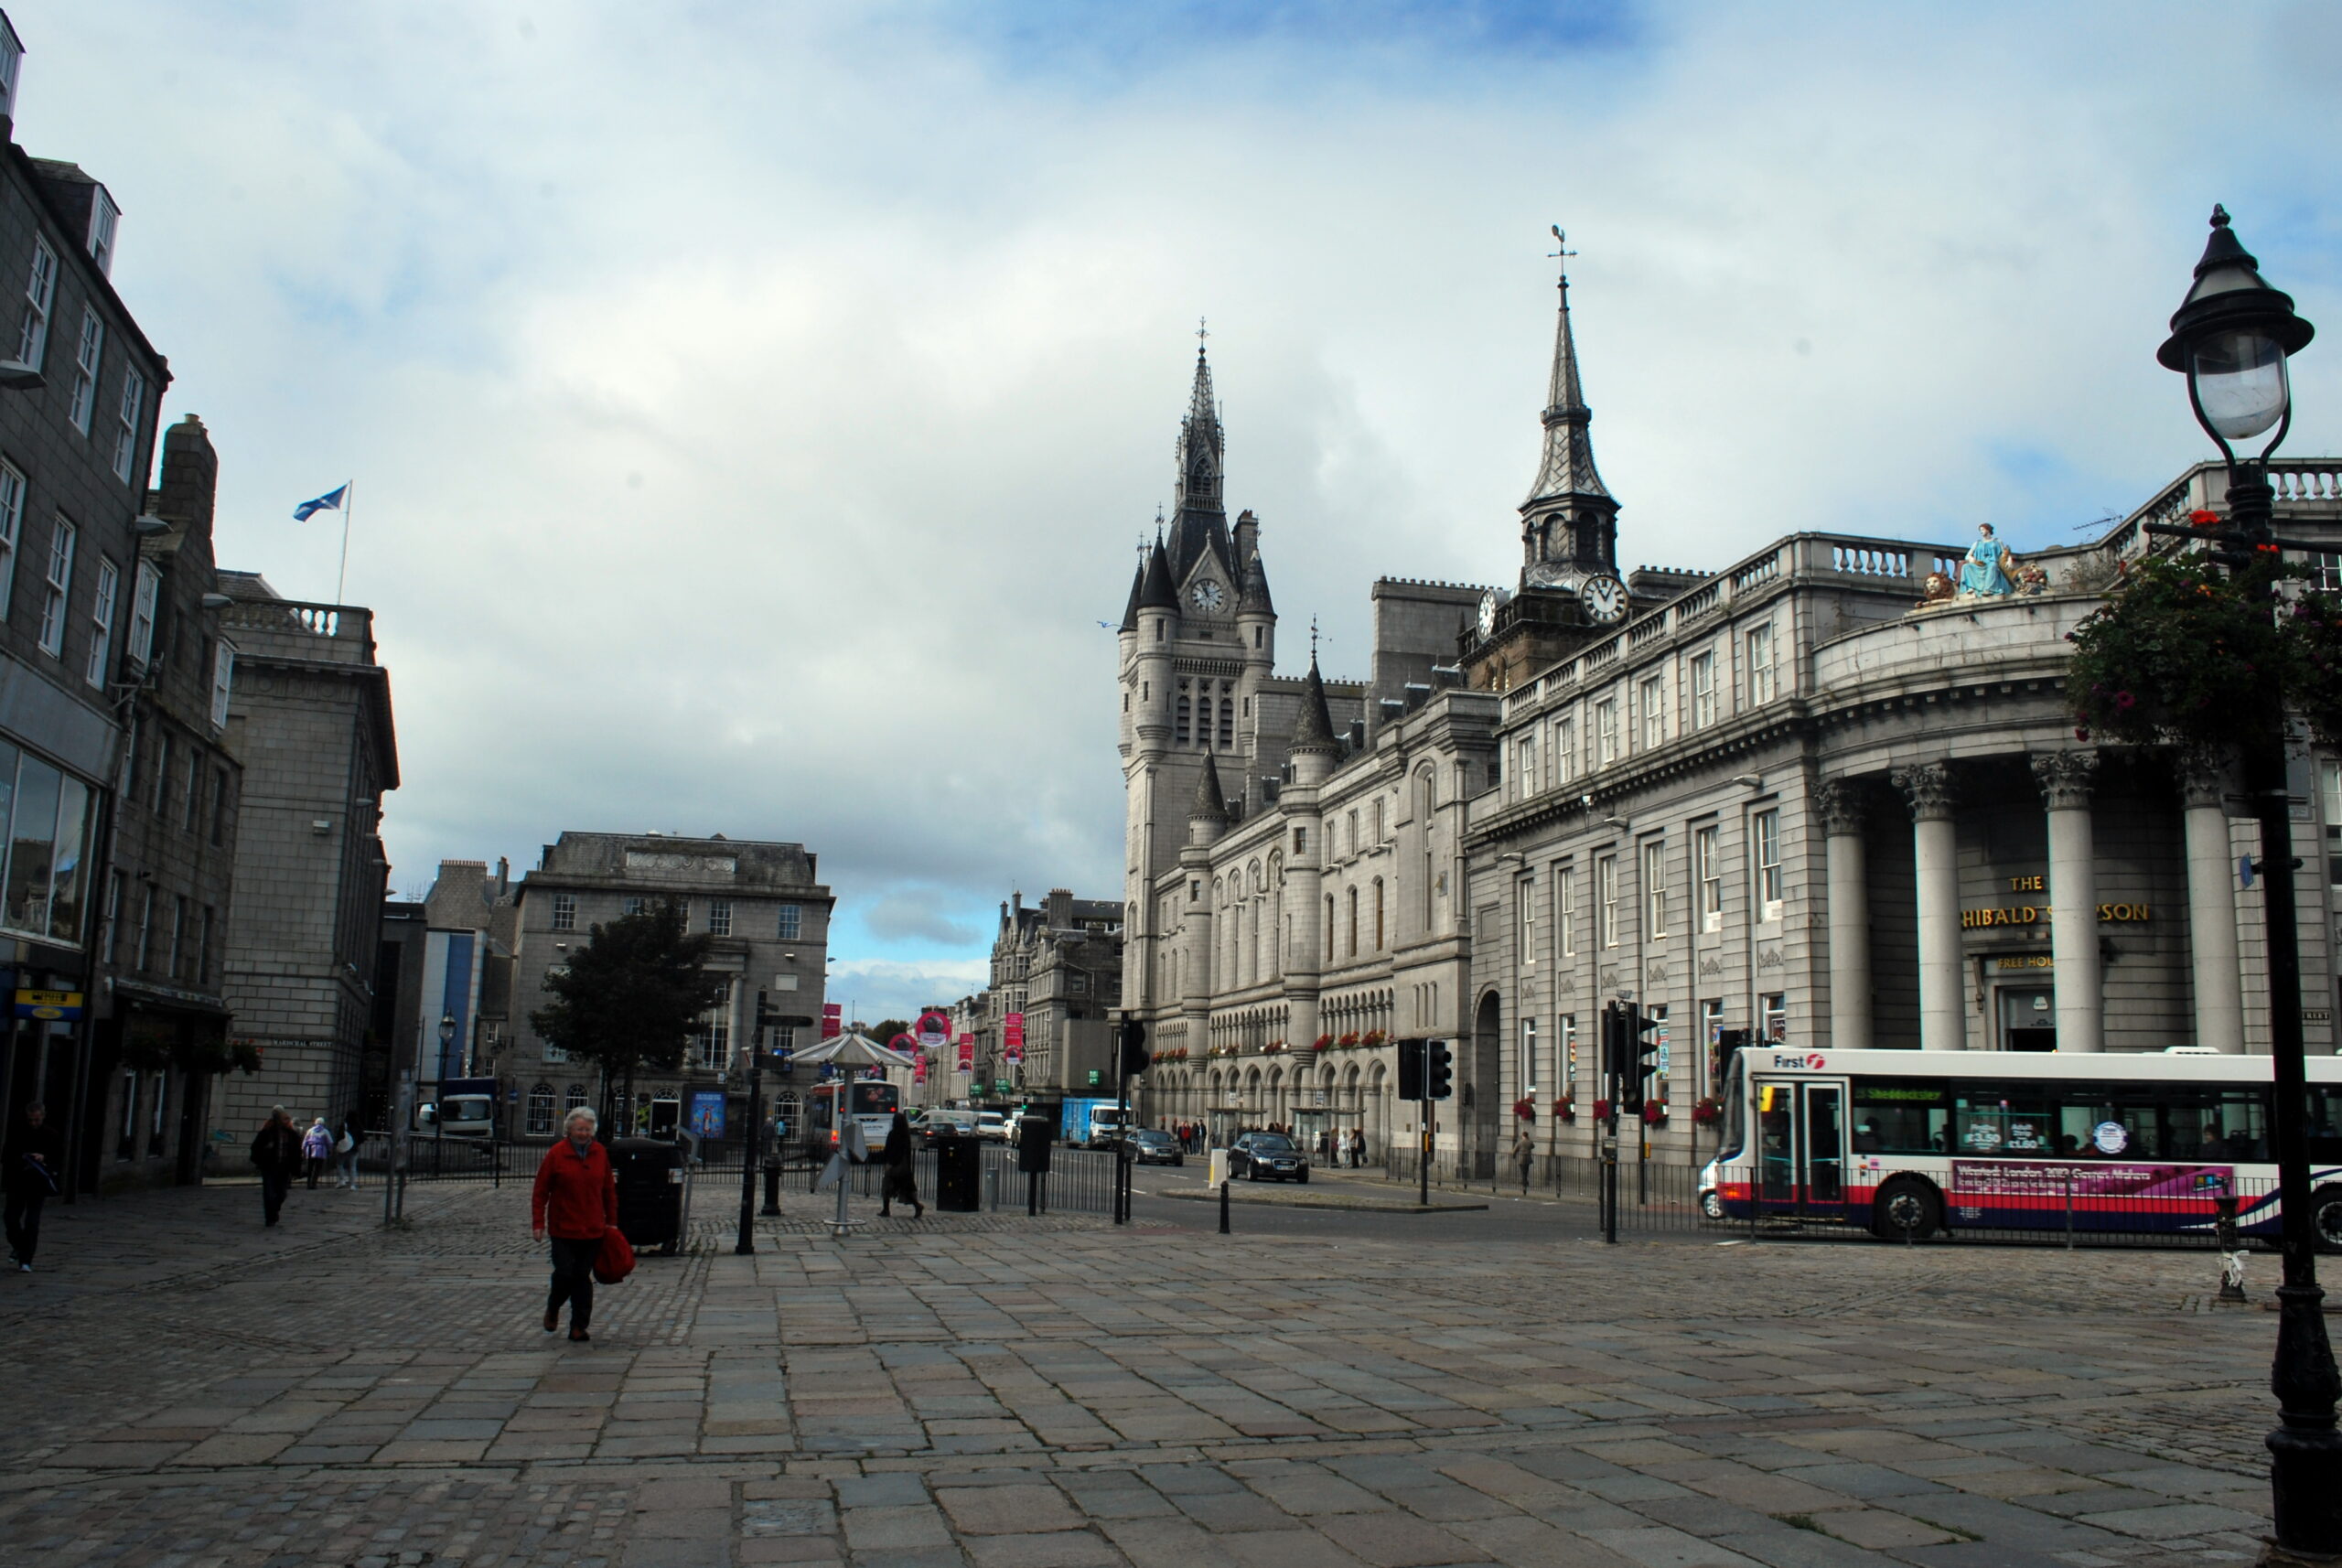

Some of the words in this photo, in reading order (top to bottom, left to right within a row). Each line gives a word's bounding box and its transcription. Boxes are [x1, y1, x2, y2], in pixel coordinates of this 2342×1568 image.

[2011, 876, 2042, 890] THE
[1962, 907, 2037, 927] HIBALD
[1998, 958, 2024, 968] FREE
[2027, 957, 2053, 967] HOU
[1774, 1055, 1804, 1068] First
[2004, 1166, 2042, 1177] London
[2045, 1167, 2068, 1178] 2012
